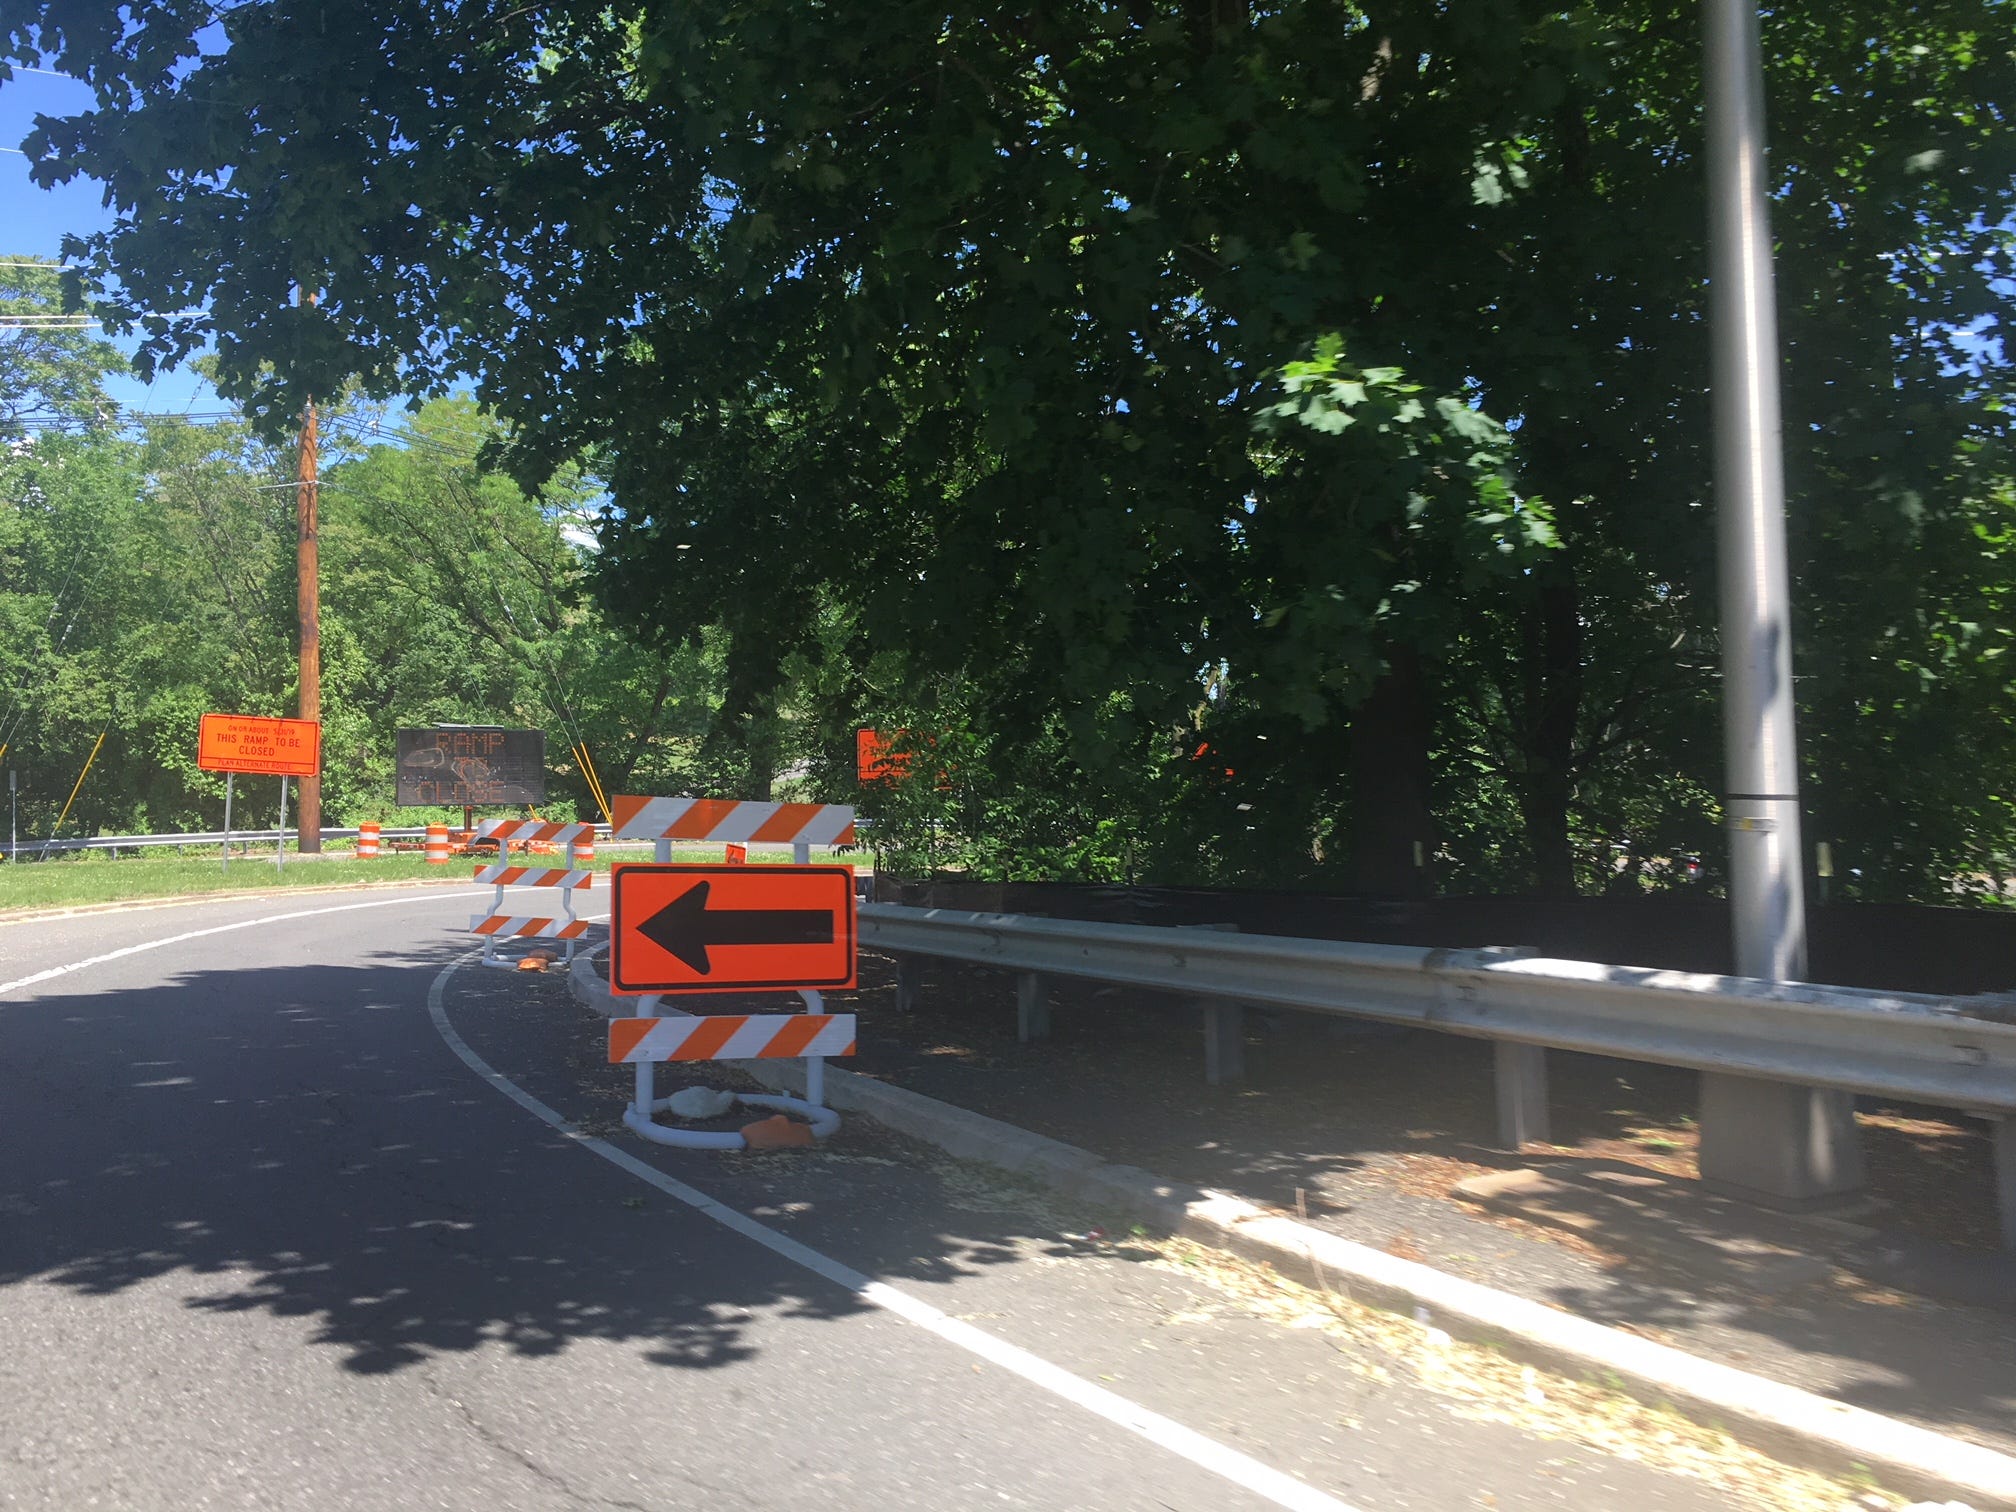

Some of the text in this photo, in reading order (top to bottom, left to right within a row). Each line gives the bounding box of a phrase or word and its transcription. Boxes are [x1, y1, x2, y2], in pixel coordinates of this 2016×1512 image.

[239, 726, 248, 734] OR
[249, 727, 269, 735] ABOUT
[217, 733, 300, 748] THIS RAMP TO BE
[436, 733, 505, 754] RAMP
[239, 746, 275, 757] CLOSED
[236, 760, 270, 769] ALTERNATE
